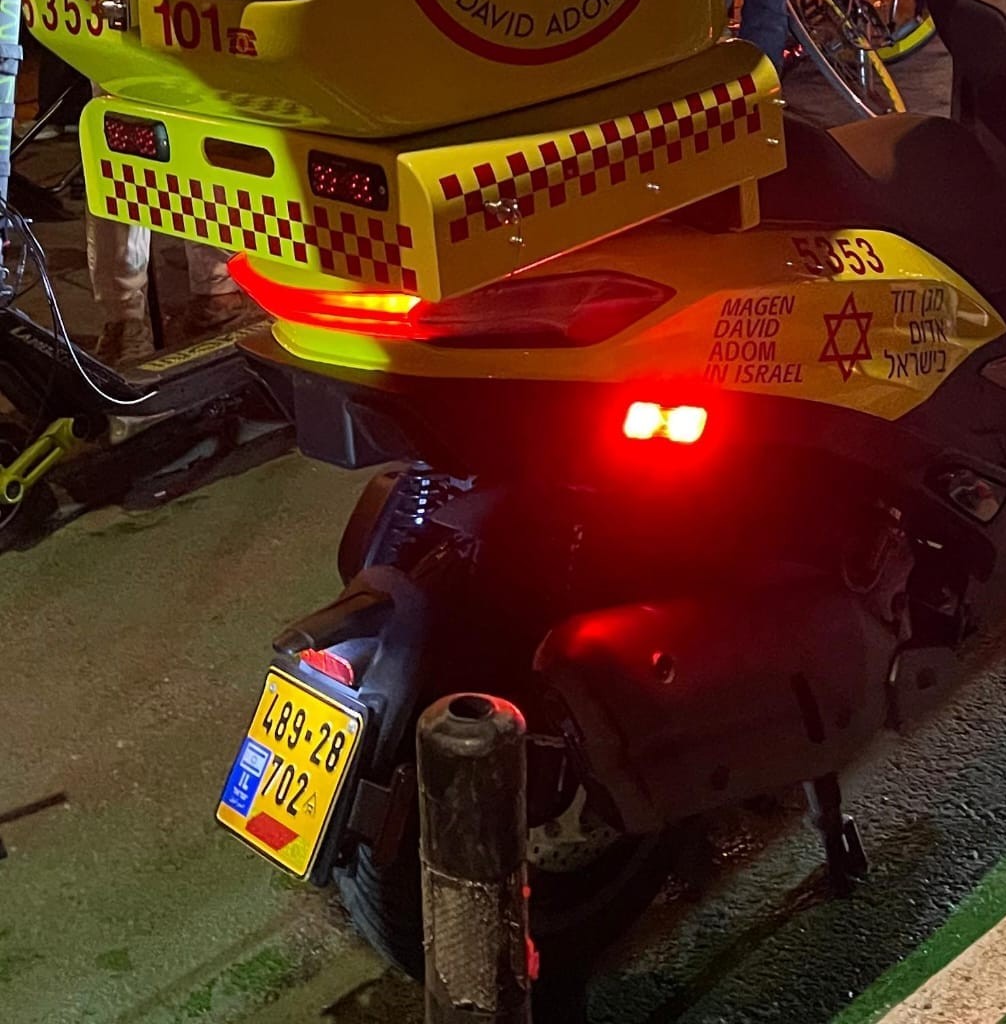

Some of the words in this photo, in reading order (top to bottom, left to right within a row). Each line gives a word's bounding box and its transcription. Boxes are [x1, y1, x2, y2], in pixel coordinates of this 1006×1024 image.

[791, 237, 885, 276] 5353
[720, 295, 796, 318] MAGEN
[891, 289, 916, 314] דוד
[921, 288, 945, 313] מגן
[713, 319, 780, 339] DAVID
[909, 319, 948, 345] אדום
[708, 341, 776, 362] ADOM
[884, 349, 947, 379] בישראל
[704, 364, 729, 384] IN
[734, 363, 803, 384] ISRAEL
[237, 771, 250, 791] IL
[260, 755, 309, 817] 702
